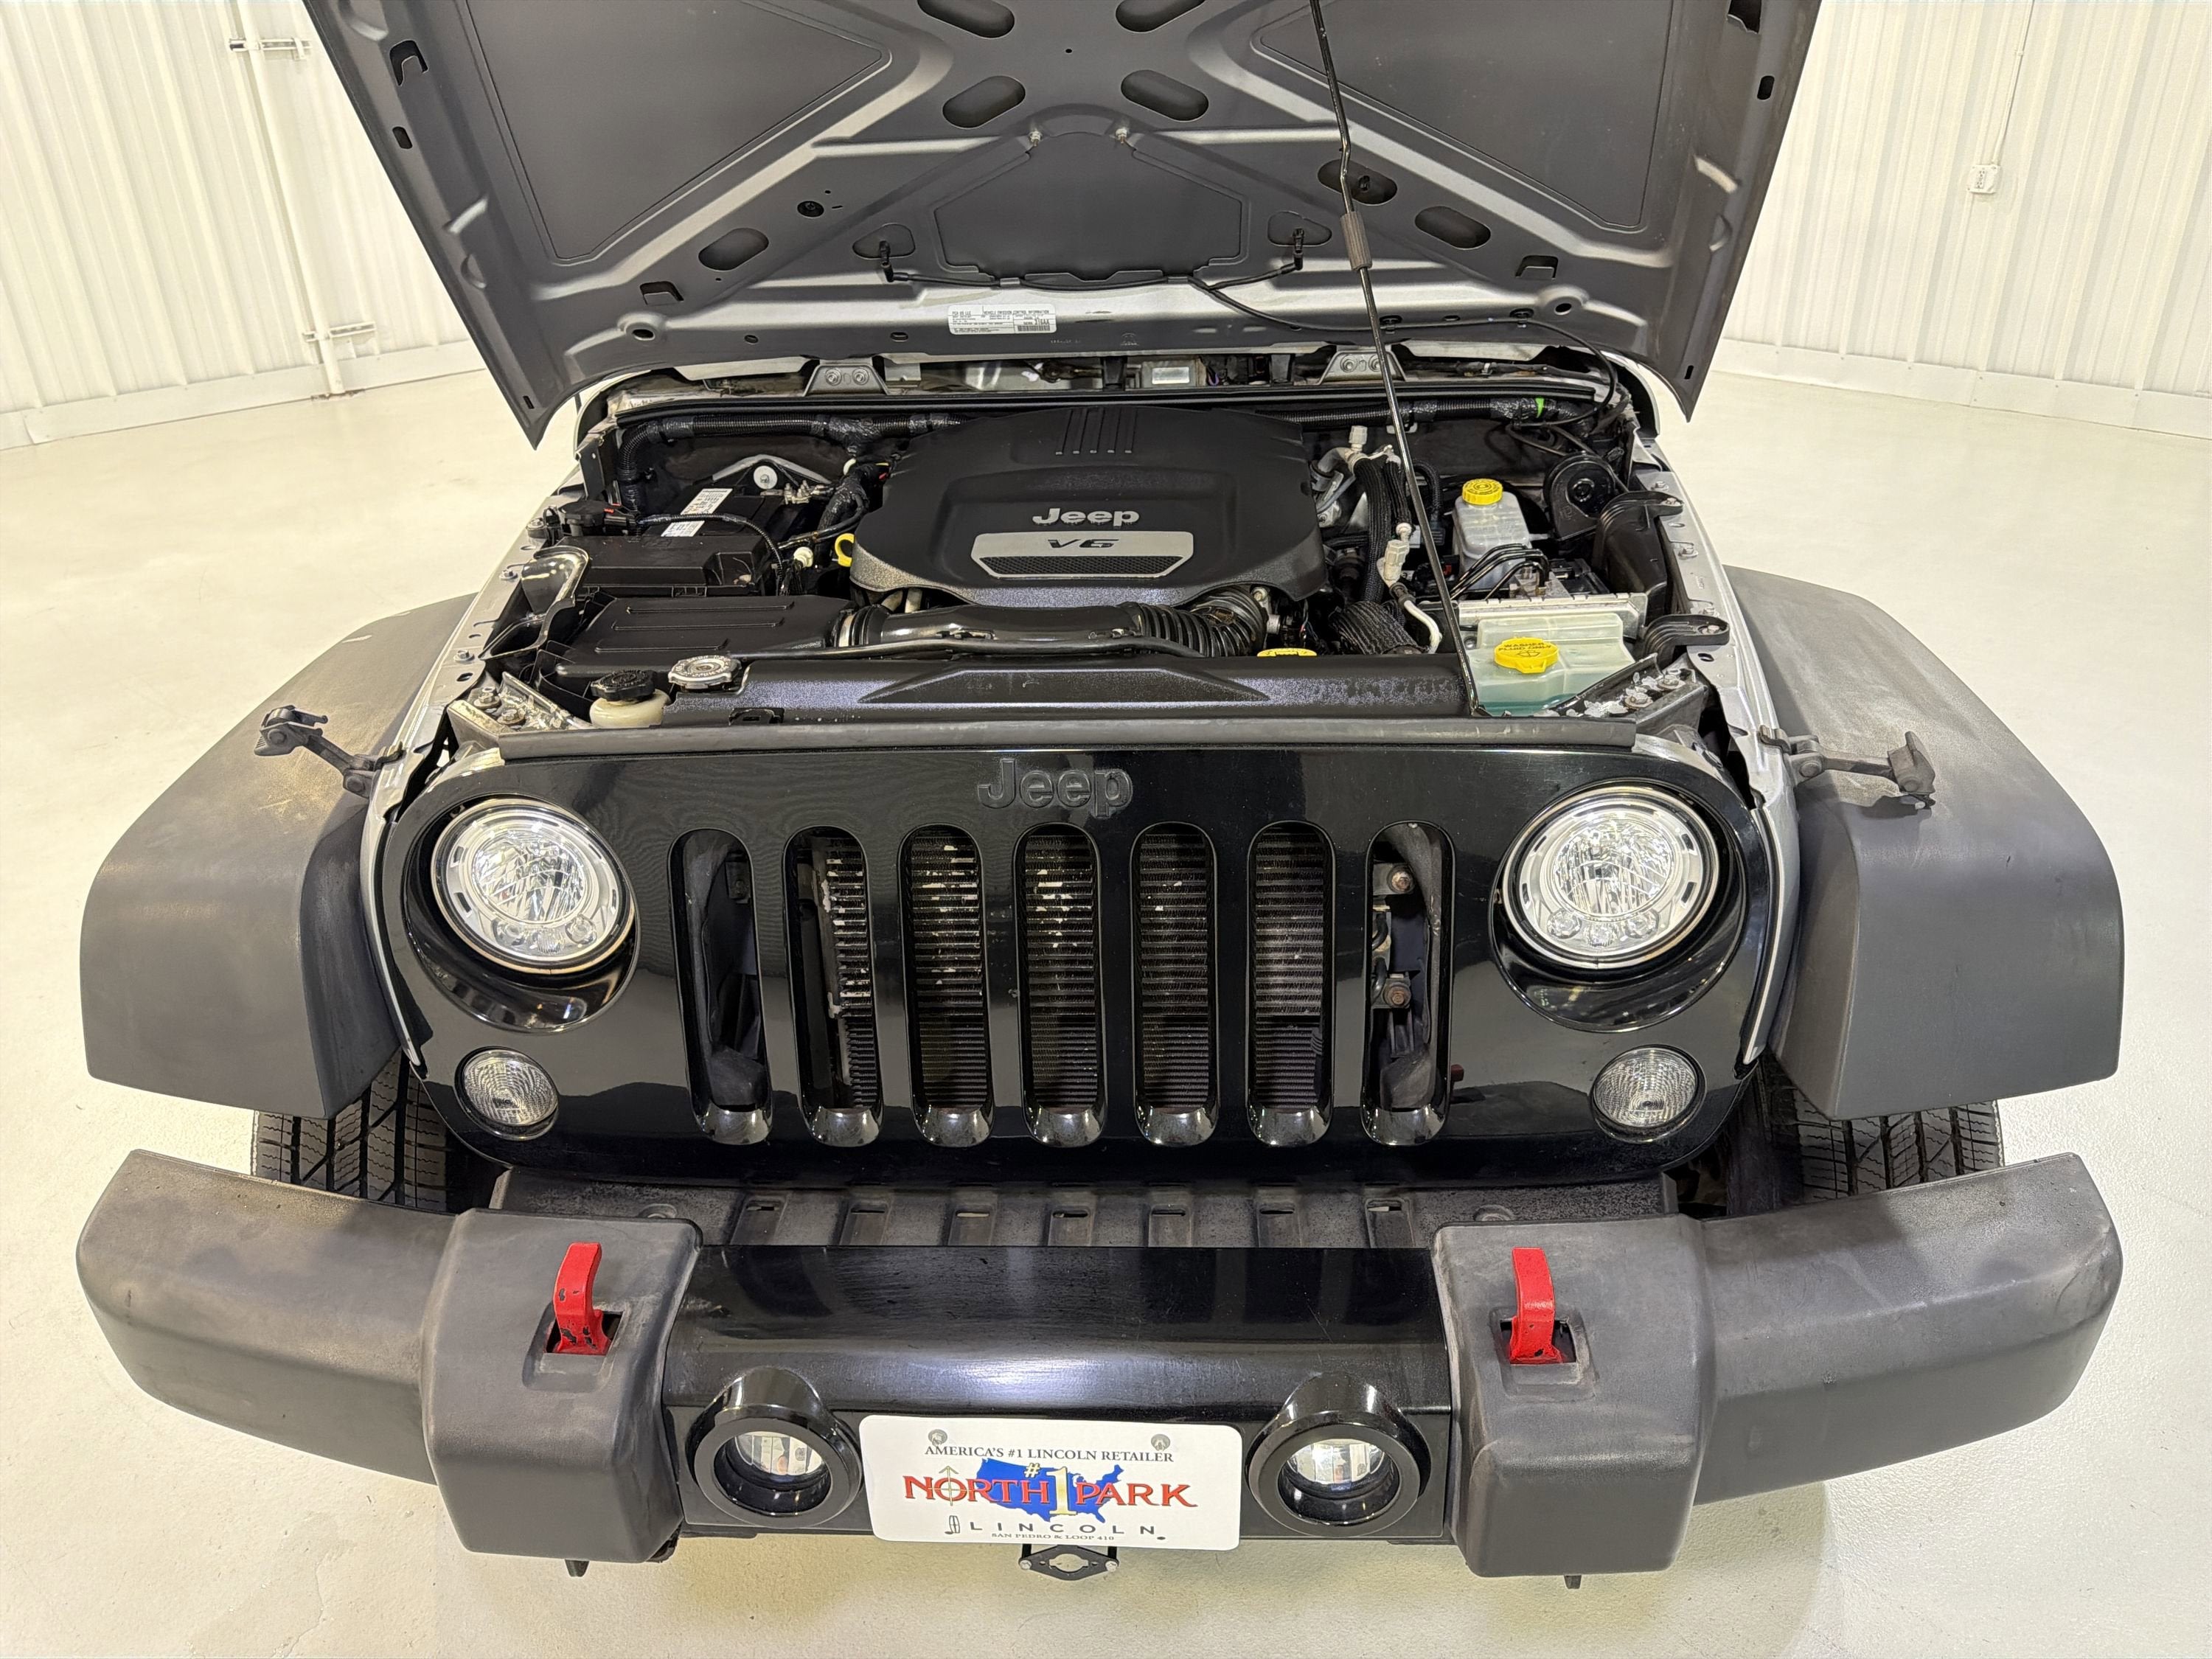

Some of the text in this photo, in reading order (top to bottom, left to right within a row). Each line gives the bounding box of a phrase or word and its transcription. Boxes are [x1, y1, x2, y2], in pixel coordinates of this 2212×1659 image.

[1032, 507, 1139, 528] Jeep
[1048, 539, 1119, 548] V6
[977, 758, 1133, 819] Jeep
[925, 1446, 1174, 1462] AMERICA'S #1 LINCOLN RETAILER
[902, 1475, 1198, 1507] NORTH PARK
[970, 1521, 1155, 1535] LINCOLN
